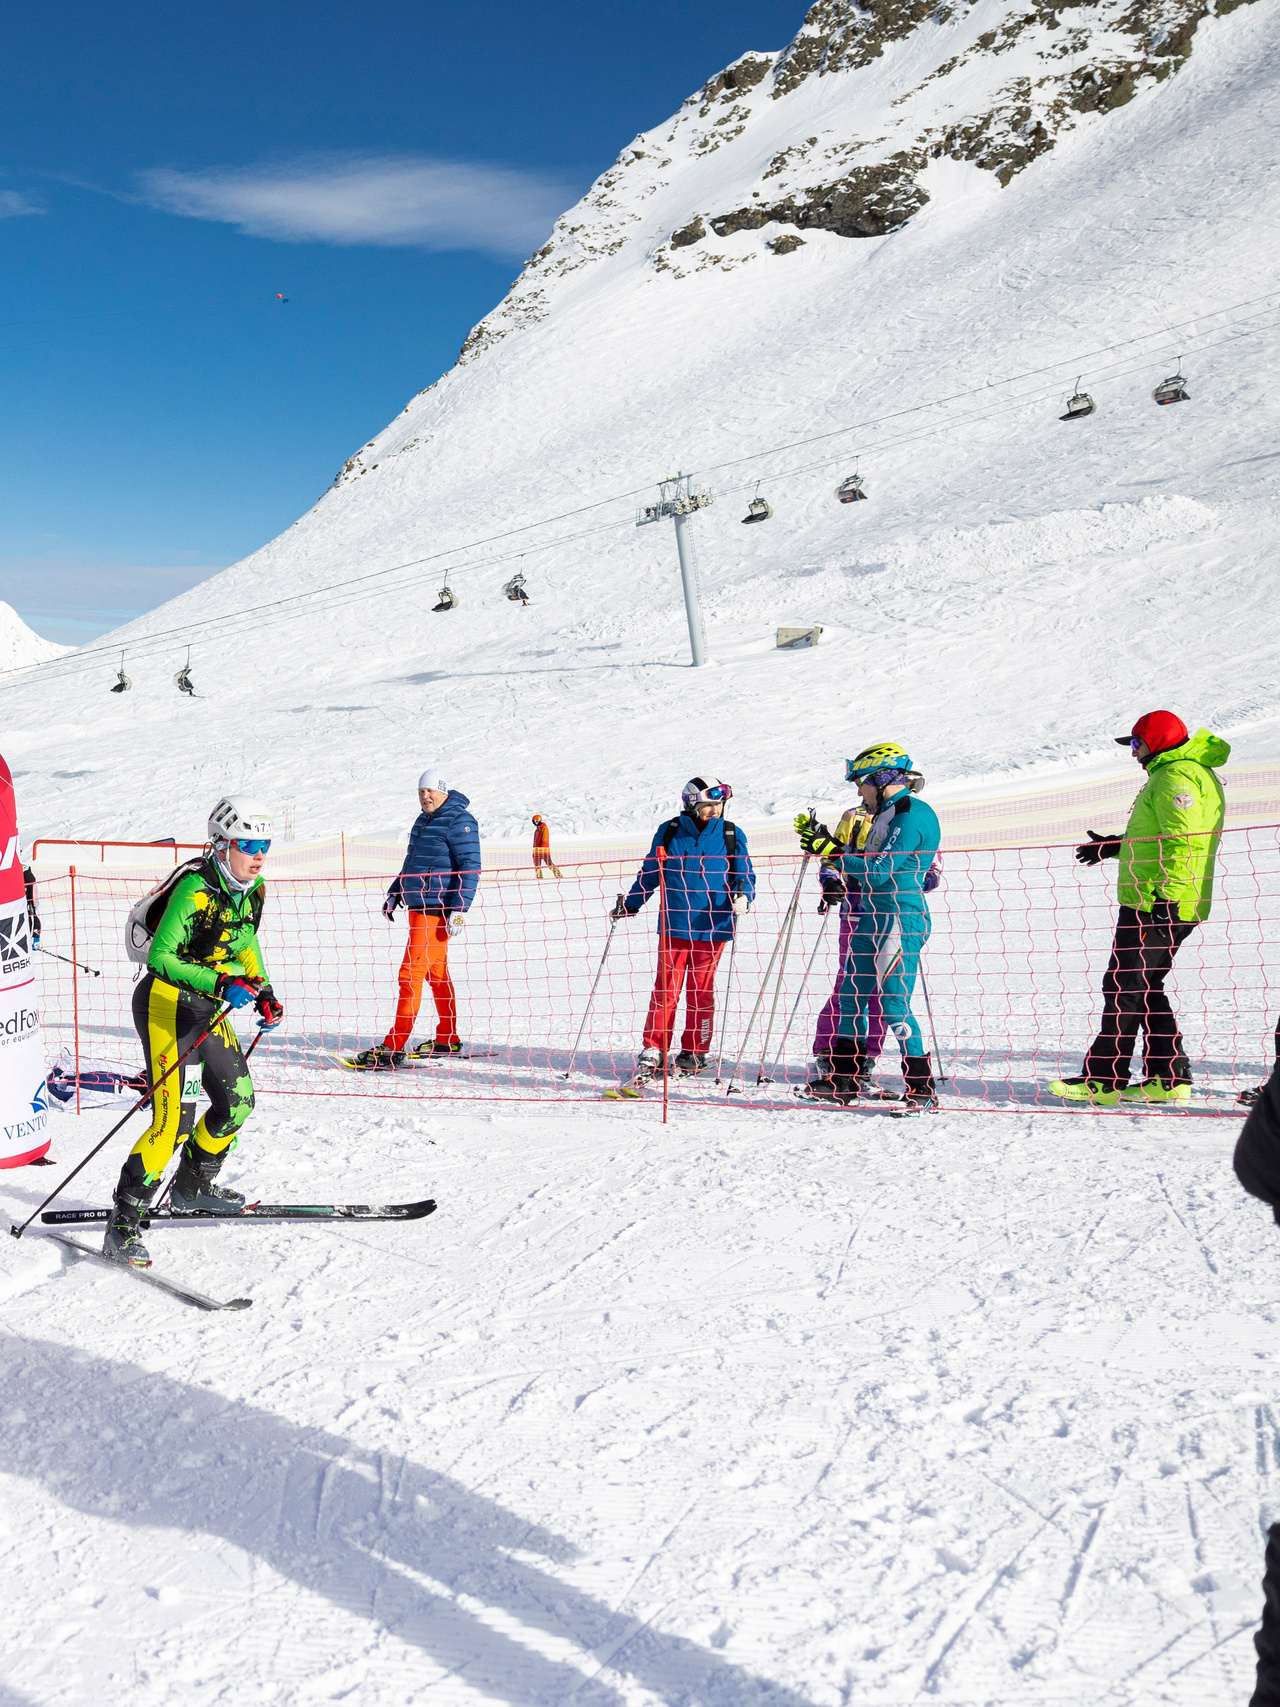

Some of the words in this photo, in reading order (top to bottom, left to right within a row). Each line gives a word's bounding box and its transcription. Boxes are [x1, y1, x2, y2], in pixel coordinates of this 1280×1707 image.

[852, 757, 898, 771] 100%
[3, 959, 32, 974] BASK
[3, 1112, 48, 1140] VENTO
